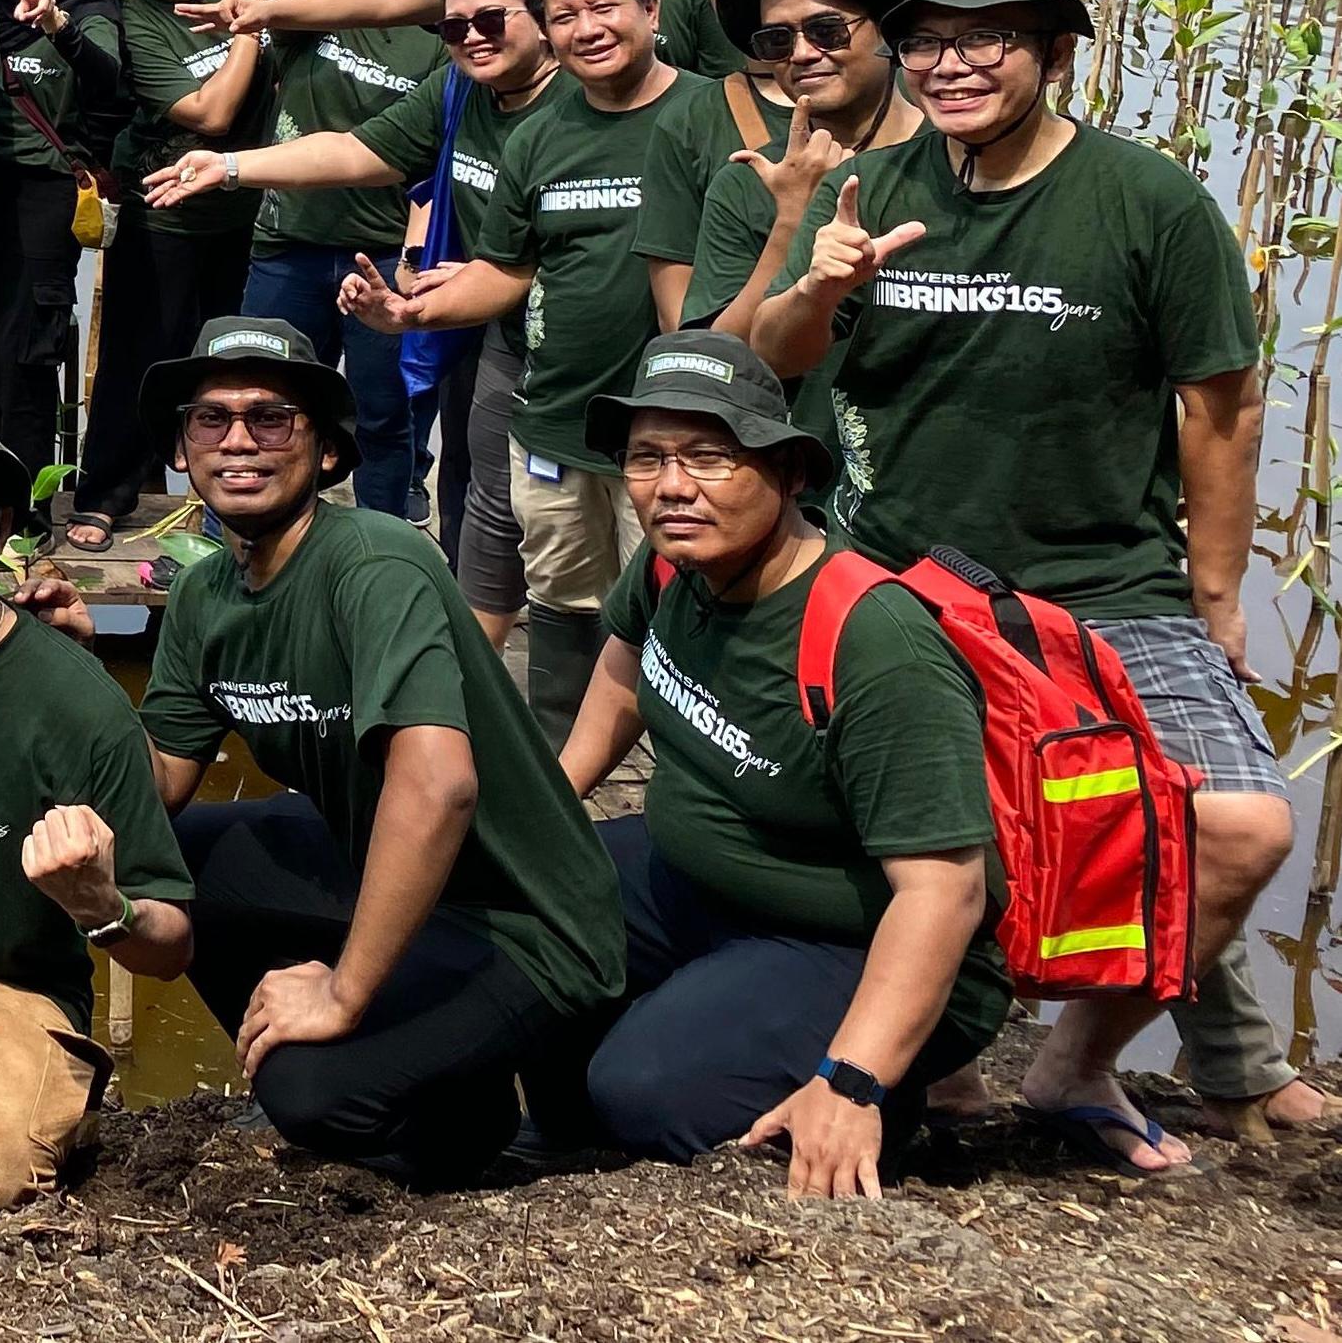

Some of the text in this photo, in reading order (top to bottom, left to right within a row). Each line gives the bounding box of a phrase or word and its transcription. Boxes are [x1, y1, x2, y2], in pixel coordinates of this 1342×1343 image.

[540, 176, 642, 192] ANNIVERSARY
[876, 268, 1012, 285] ANNIVERSARY
[1050, 302, 1103, 331] years
[662, 357, 726, 377] BRINKS
[733, 750, 783, 779] years
